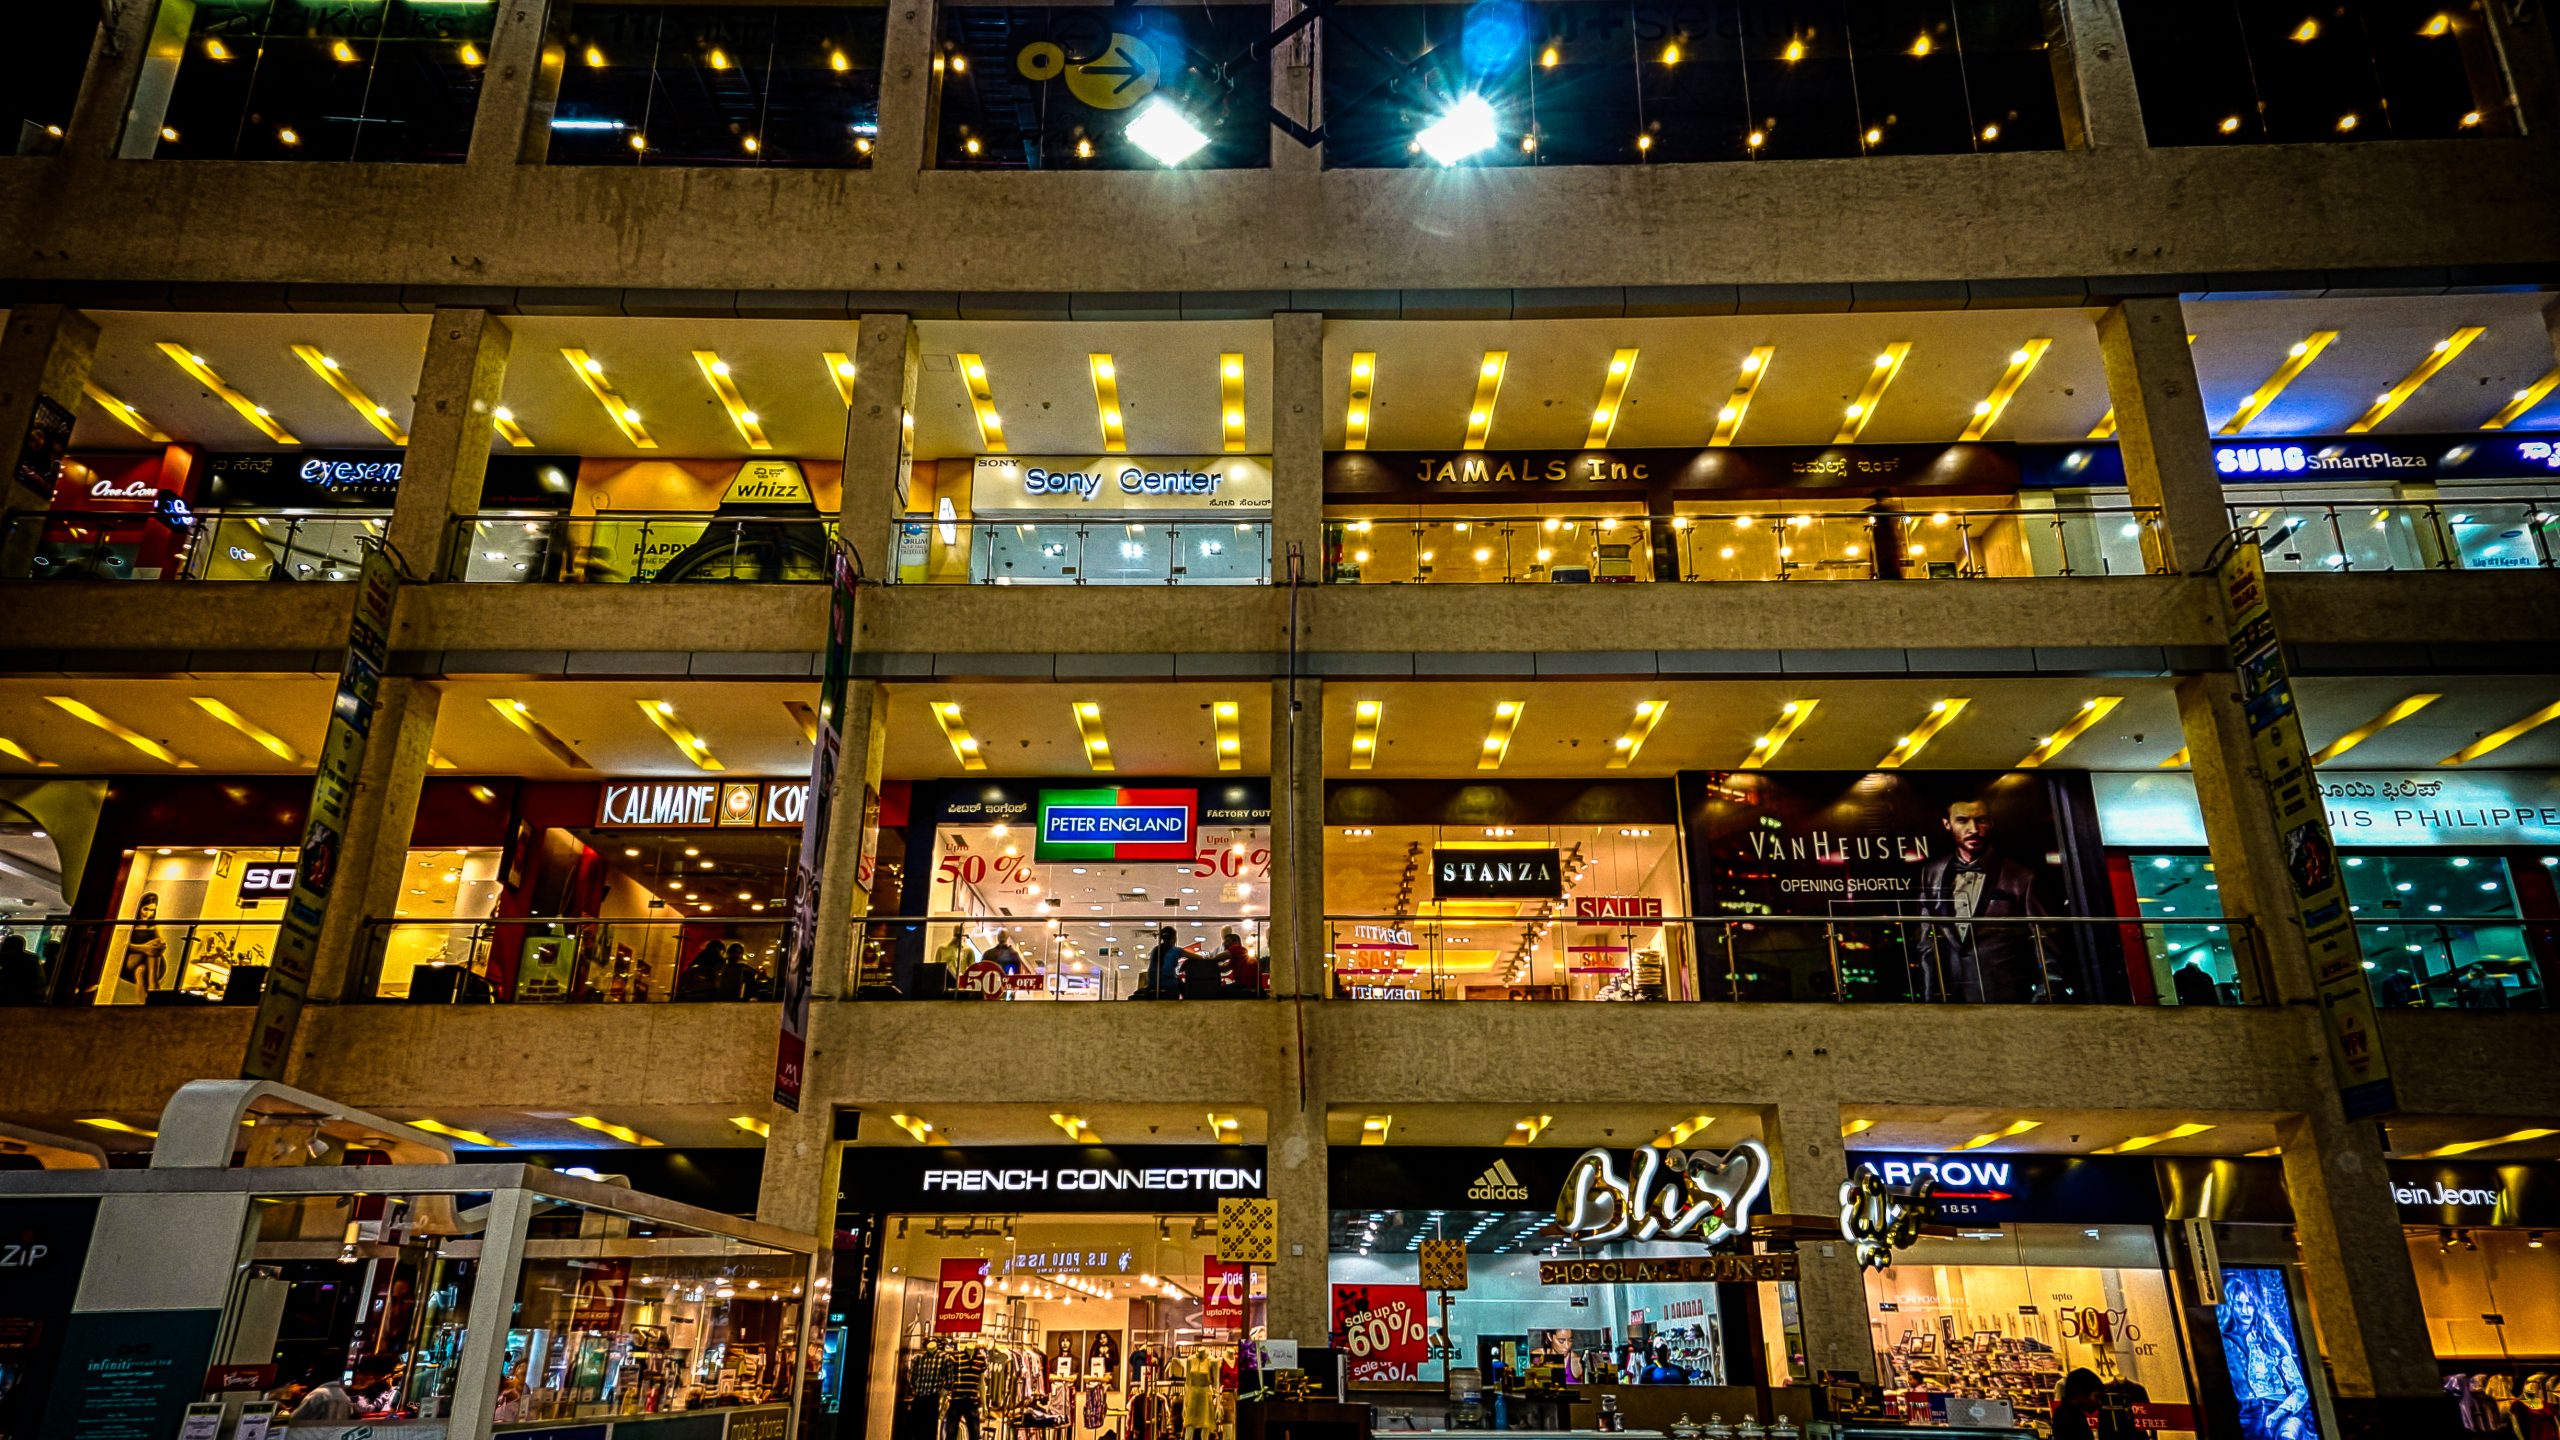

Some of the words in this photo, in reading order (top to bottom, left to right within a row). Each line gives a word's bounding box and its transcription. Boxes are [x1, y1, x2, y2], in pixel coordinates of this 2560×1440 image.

[978, 459, 1020, 467] SONY
[2216, 447, 2307, 473] SUNG
[2308, 452, 2428, 471] SmartPlaza
[1417, 458, 1568, 484] JAMALS
[1588, 458, 1649, 481] Inc
[737, 482, 799, 498] whizz
[1026, 468, 1101, 496] Sony
[1120, 468, 1222, 492] Center
[602, 785, 715, 824] KALMANE
[1207, 809, 1249, 818] FACTORY
[1252, 809, 1271, 817] OUT
[1051, 817, 1096, 832] PETER
[1099, 817, 1182, 832] ENGLAND
[2394, 808, 2560, 827] PHILIPPE
[945, 842, 969, 854] Upto
[1206, 835, 1229, 846] Upto
[1443, 862, 1551, 882] STANZA
[1781, 879, 1843, 893] OPENING
[1847, 878, 1911, 892] SHORTLY
[1580, 899, 1660, 919] SALE
[1016, 978, 1036, 987] OFF
[923, 1170, 1048, 1191] FRENCH
[1056, 1168, 1262, 1190] CONNECTION
[1864, 1162, 2010, 1187] ARROW
[1468, 1185, 1529, 1200] adidas
[2435, 1182, 2498, 1206] Jeans
[1941, 1204, 1978, 1213] 1851
[1540, 1261, 1681, 1284] CHOCOLATE
[942, 1280, 984, 1309] 70
[2052, 1293, 2073, 1302] upto
[1345, 1311, 1372, 1327] sale
[1373, 1306, 1390, 1318] up
[1392, 1301, 1406, 1312] to
[1348, 1308, 1424, 1357] 60%
[2060, 1306, 2141, 1343] 50%
[2135, 1344, 2158, 1356] off
[1354, 1361, 1378, 1375] sale
